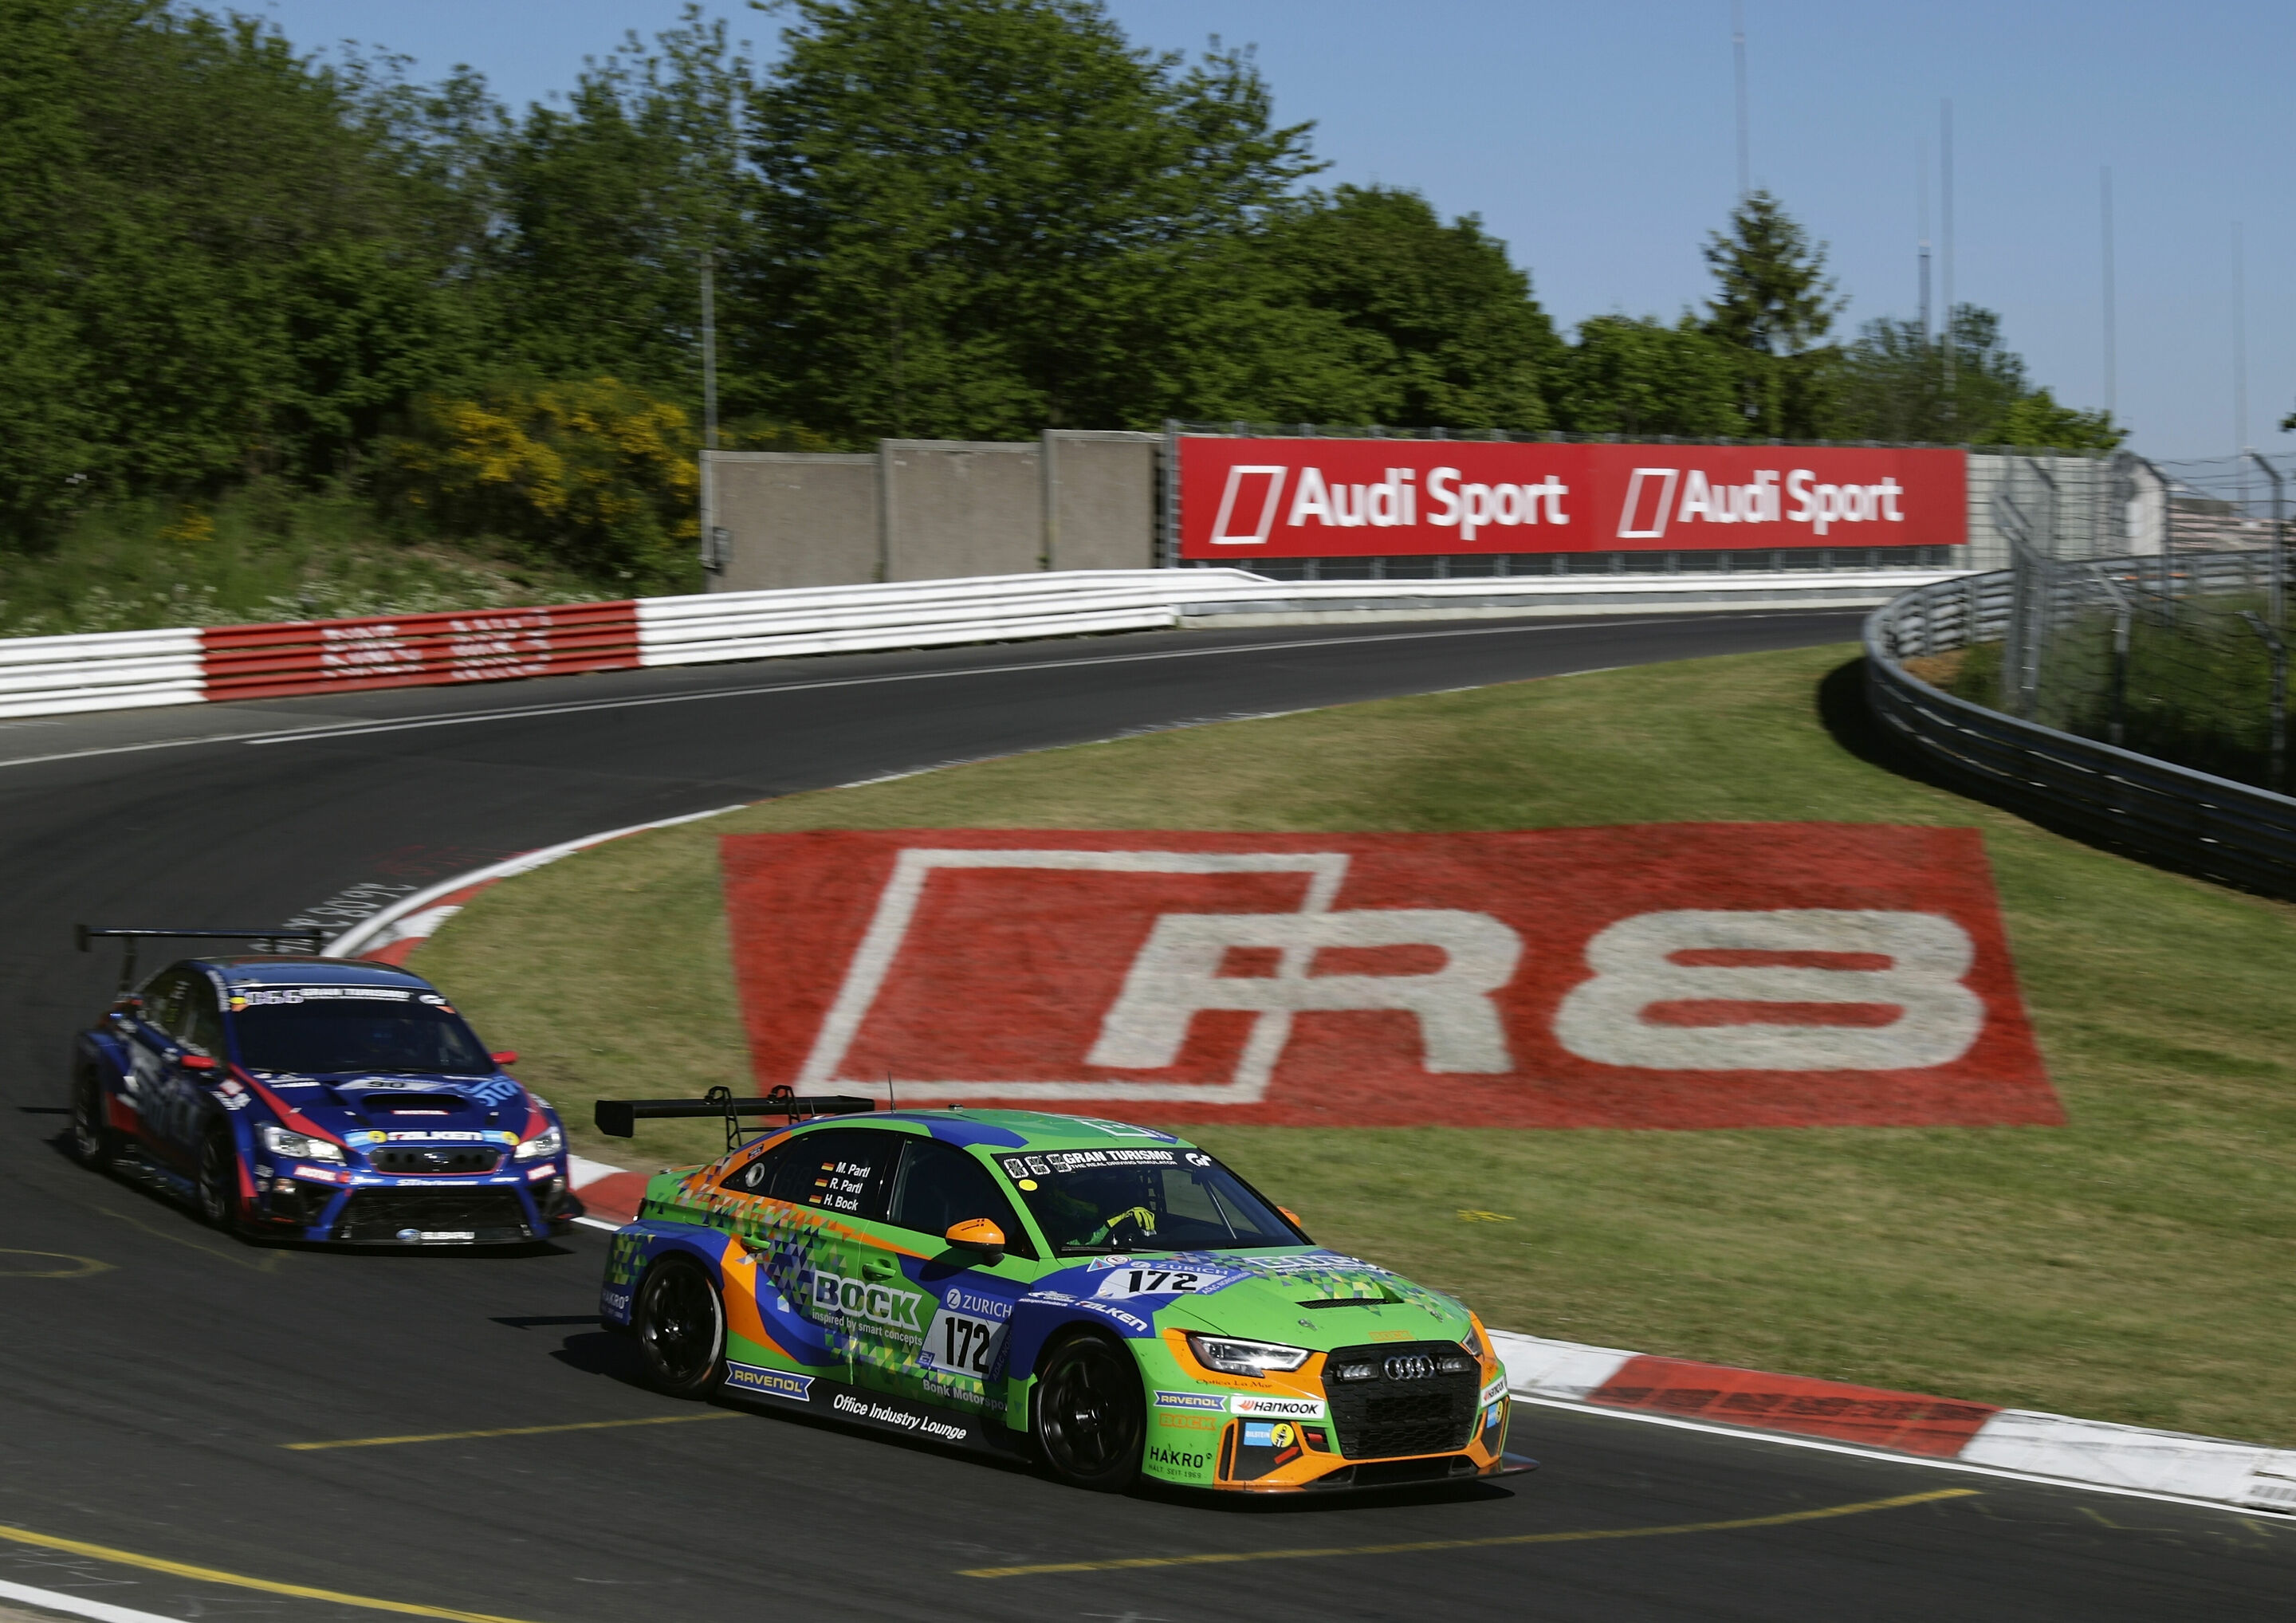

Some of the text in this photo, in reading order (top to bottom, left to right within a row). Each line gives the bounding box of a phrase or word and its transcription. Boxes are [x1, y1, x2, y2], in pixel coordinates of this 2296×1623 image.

[1288, 466, 1570, 540] Audi Sport
[1677, 469, 1905, 536] Audi Sport
[1083, 908, 1985, 1072] R8
[387, 1130, 483, 1141] FALKEN
[835, 1161, 846, 1173] M.
[1063, 1150, 1177, 1165] GRAN TURISMO
[829, 1177, 839, 1189] R.
[824, 1193, 859, 1211] H. Bock
[421, 1231, 475, 1240] SUBARU
[1155, 1263, 1229, 1275] ZURICH
[1129, 1270, 1198, 1293] 172
[812, 1269, 922, 1333] BOCK
[962, 1294, 1012, 1318] ZURICH
[1075, 1300, 1148, 1332] FALKEN
[812, 1308, 922, 1346] inspired by smart concepts
[946, 1316, 990, 1374] 172
[734, 1370, 803, 1393] RAVENOL
[923, 1378, 950, 1397] Bonk
[1161, 1395, 1219, 1408] RAVENOL
[833, 1393, 967, 1440] Office Industry Lounge
[1159, 1413, 1217, 1431] BOCK
[1244, 1428, 1271, 1440] BILSTEIN
[1150, 1446, 1204, 1468] HAKRO
[1148, 1464, 1164, 1472] HALT
